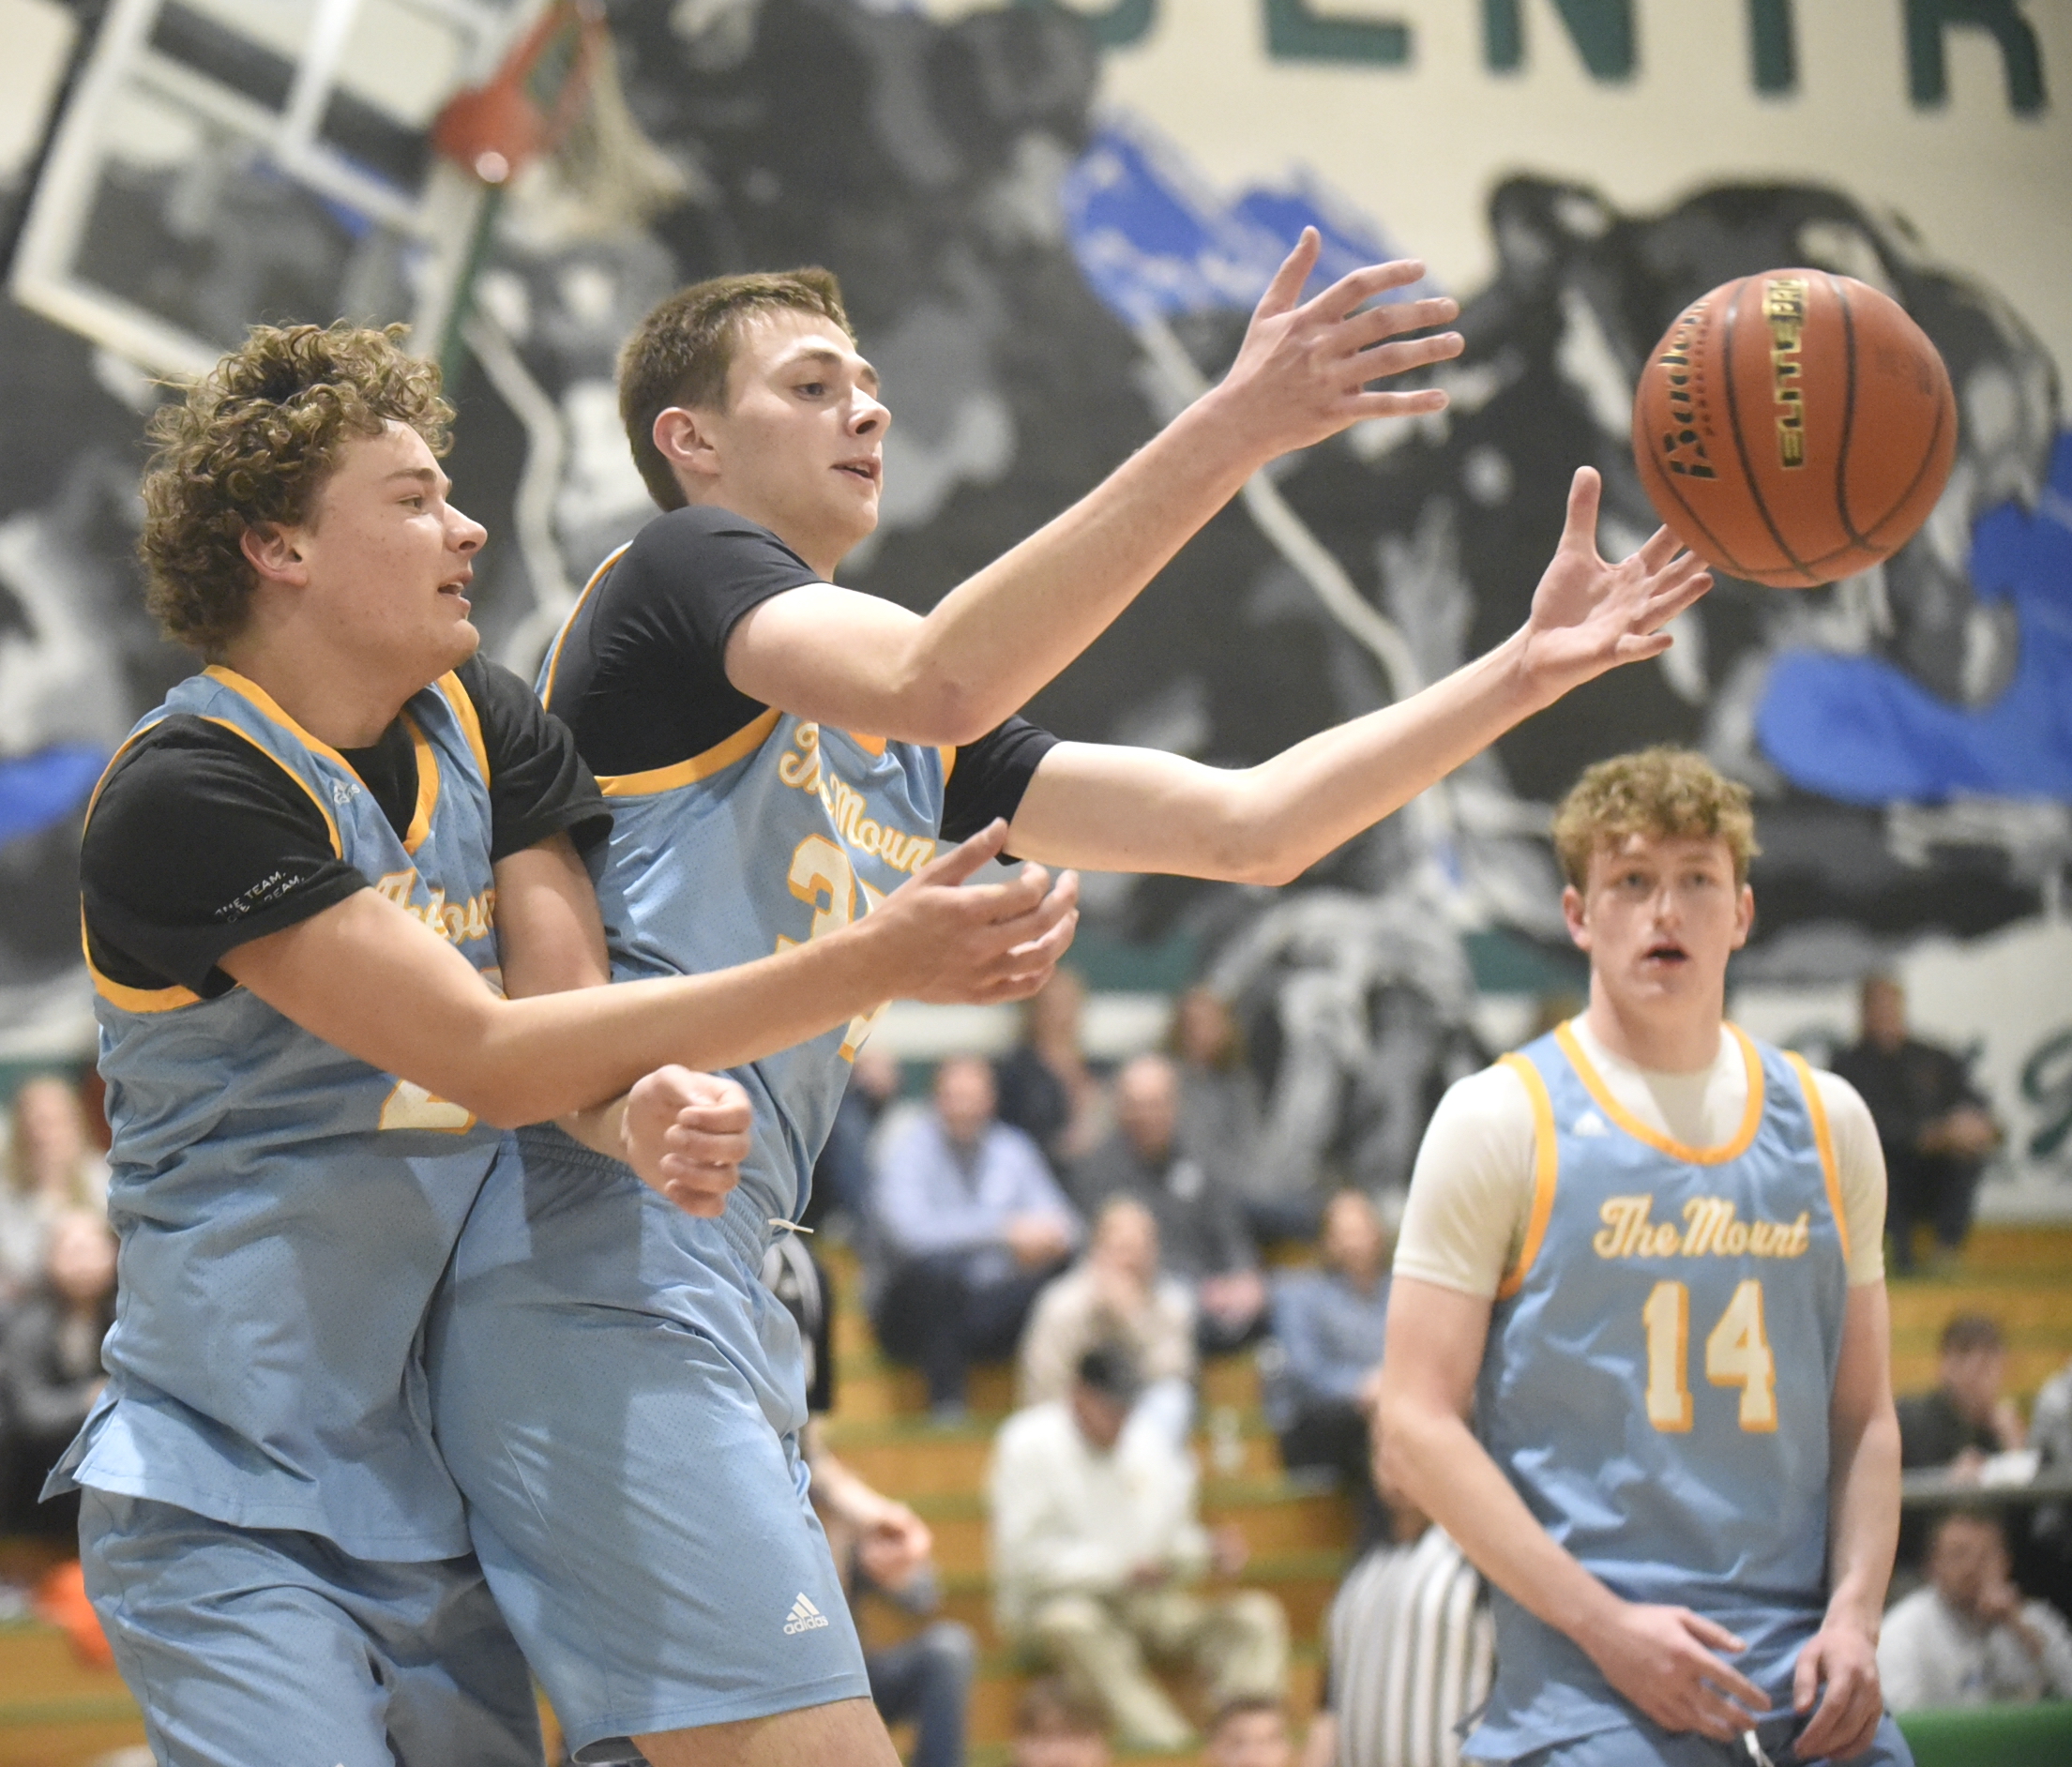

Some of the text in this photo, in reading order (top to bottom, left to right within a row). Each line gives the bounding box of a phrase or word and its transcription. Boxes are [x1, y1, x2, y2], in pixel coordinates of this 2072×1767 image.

[1770, 325, 1806, 470] ELITE
[828, 771, 936, 876] Moun
[1592, 1193, 1811, 1259] The Mount
[1641, 1278, 1779, 1433] 14
[782, 1615, 830, 1636] adidas
